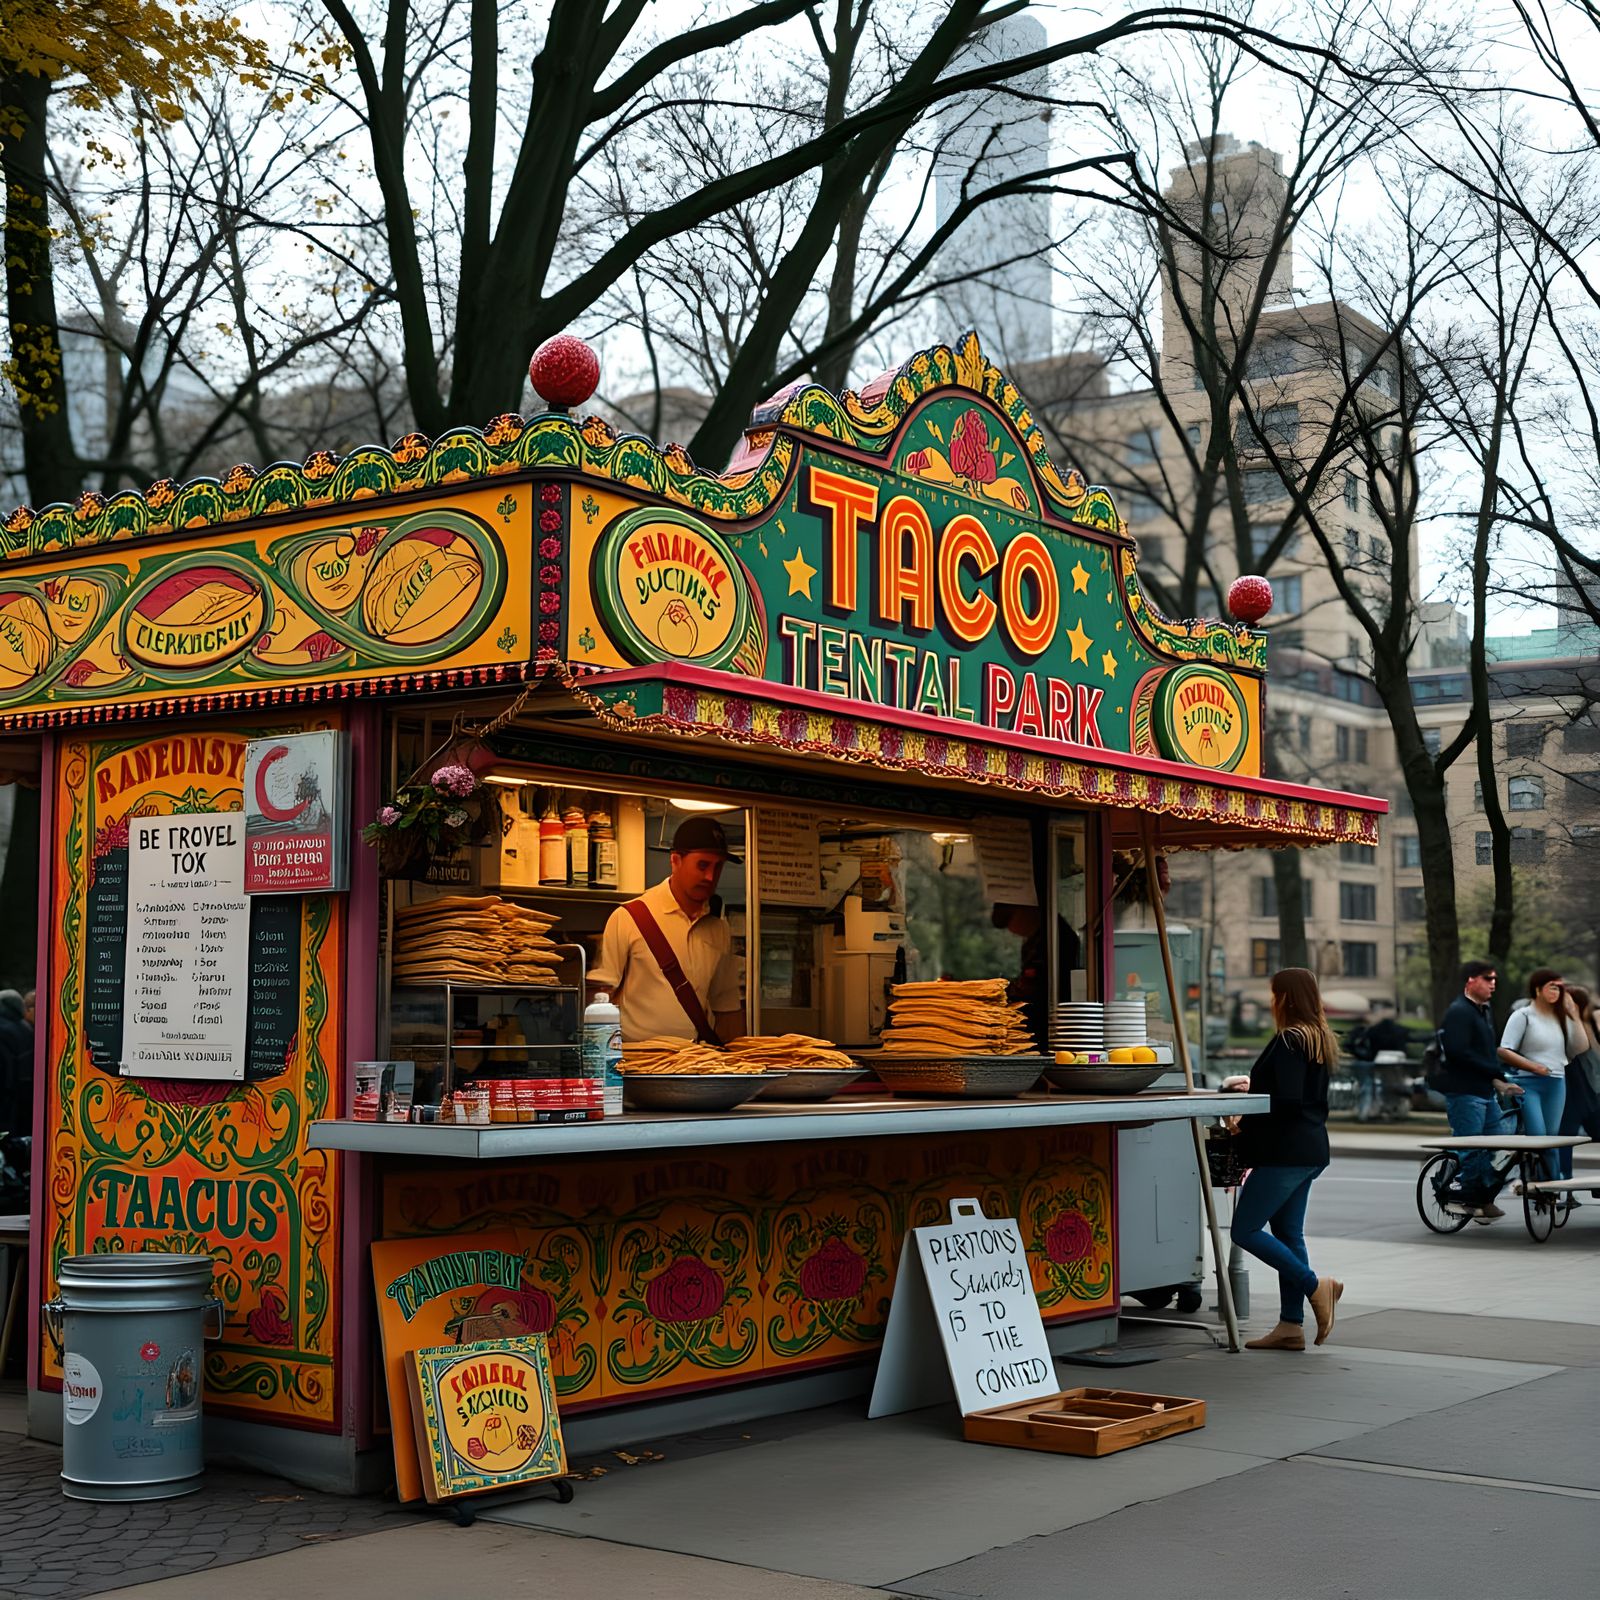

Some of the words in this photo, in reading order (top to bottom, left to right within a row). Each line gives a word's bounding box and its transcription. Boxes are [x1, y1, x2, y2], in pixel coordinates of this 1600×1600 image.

[809, 465, 1060, 656] TACO
[778, 614, 976, 723] TENTAL
[981, 661, 1105, 749] PARK
[139, 828, 160, 850] BE
[92, 1168, 278, 1242] TAACUS
[979, 1300, 1006, 1324] TO
